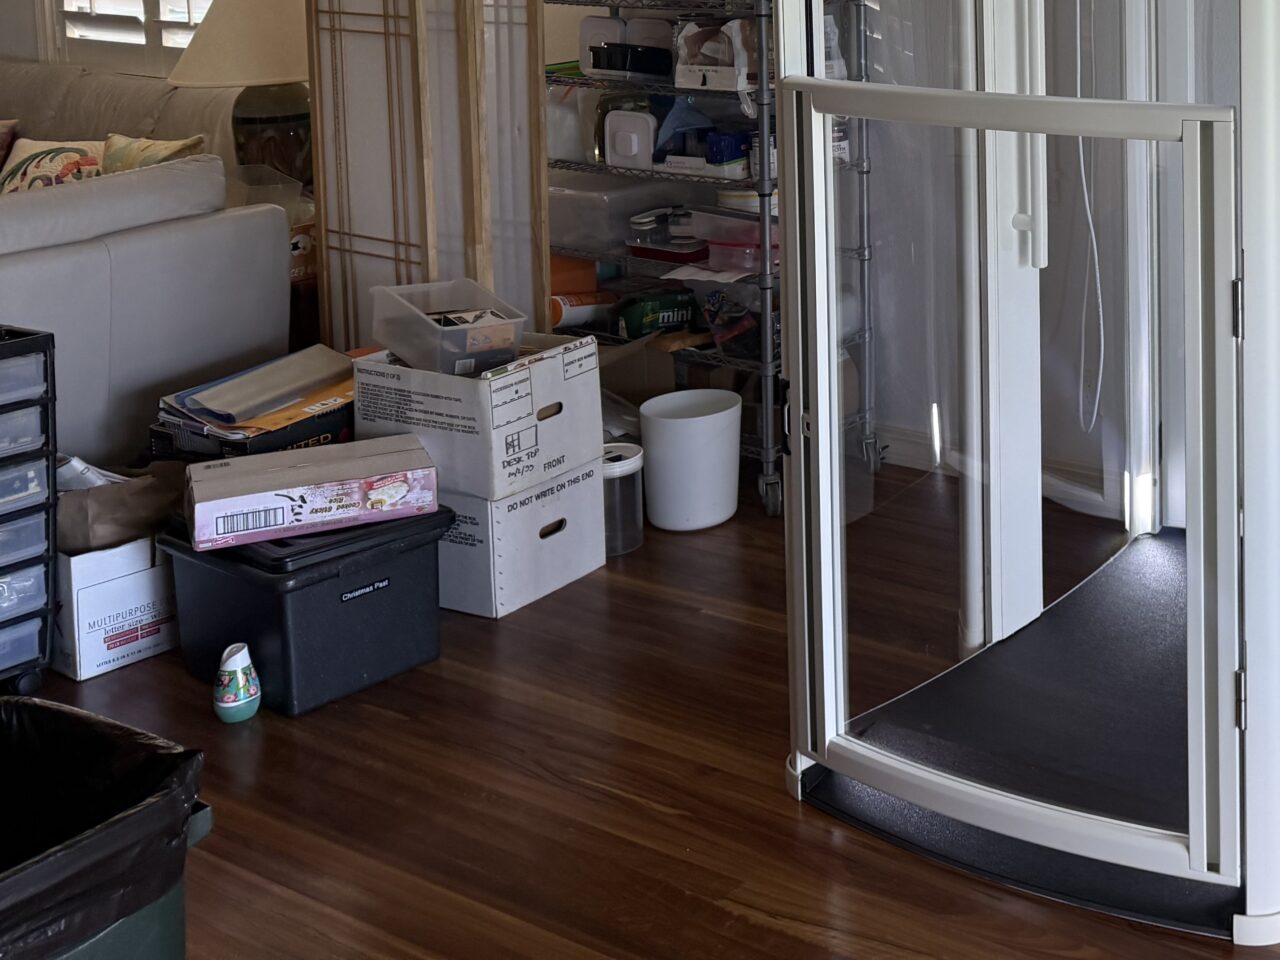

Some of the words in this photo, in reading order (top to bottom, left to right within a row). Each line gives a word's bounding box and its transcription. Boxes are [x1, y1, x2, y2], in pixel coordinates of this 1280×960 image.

[659, 306, 692, 323] mini
[502, 456, 524, 470] DESK
[525, 448, 540, 460] TOP
[543, 455, 565, 472] FRONT
[507, 502, 518, 513] DO
[519, 496, 533, 508] NOT
[534, 487, 555, 501] WRITE
[556, 483, 566, 492] ON
[567, 476, 581, 487] THIS
[581, 470, 594, 481] END
[342, 586, 374, 601] Christmas
[374, 579, 389, 589] Past
[88, 601, 157, 630] MULTIPURPOSE
